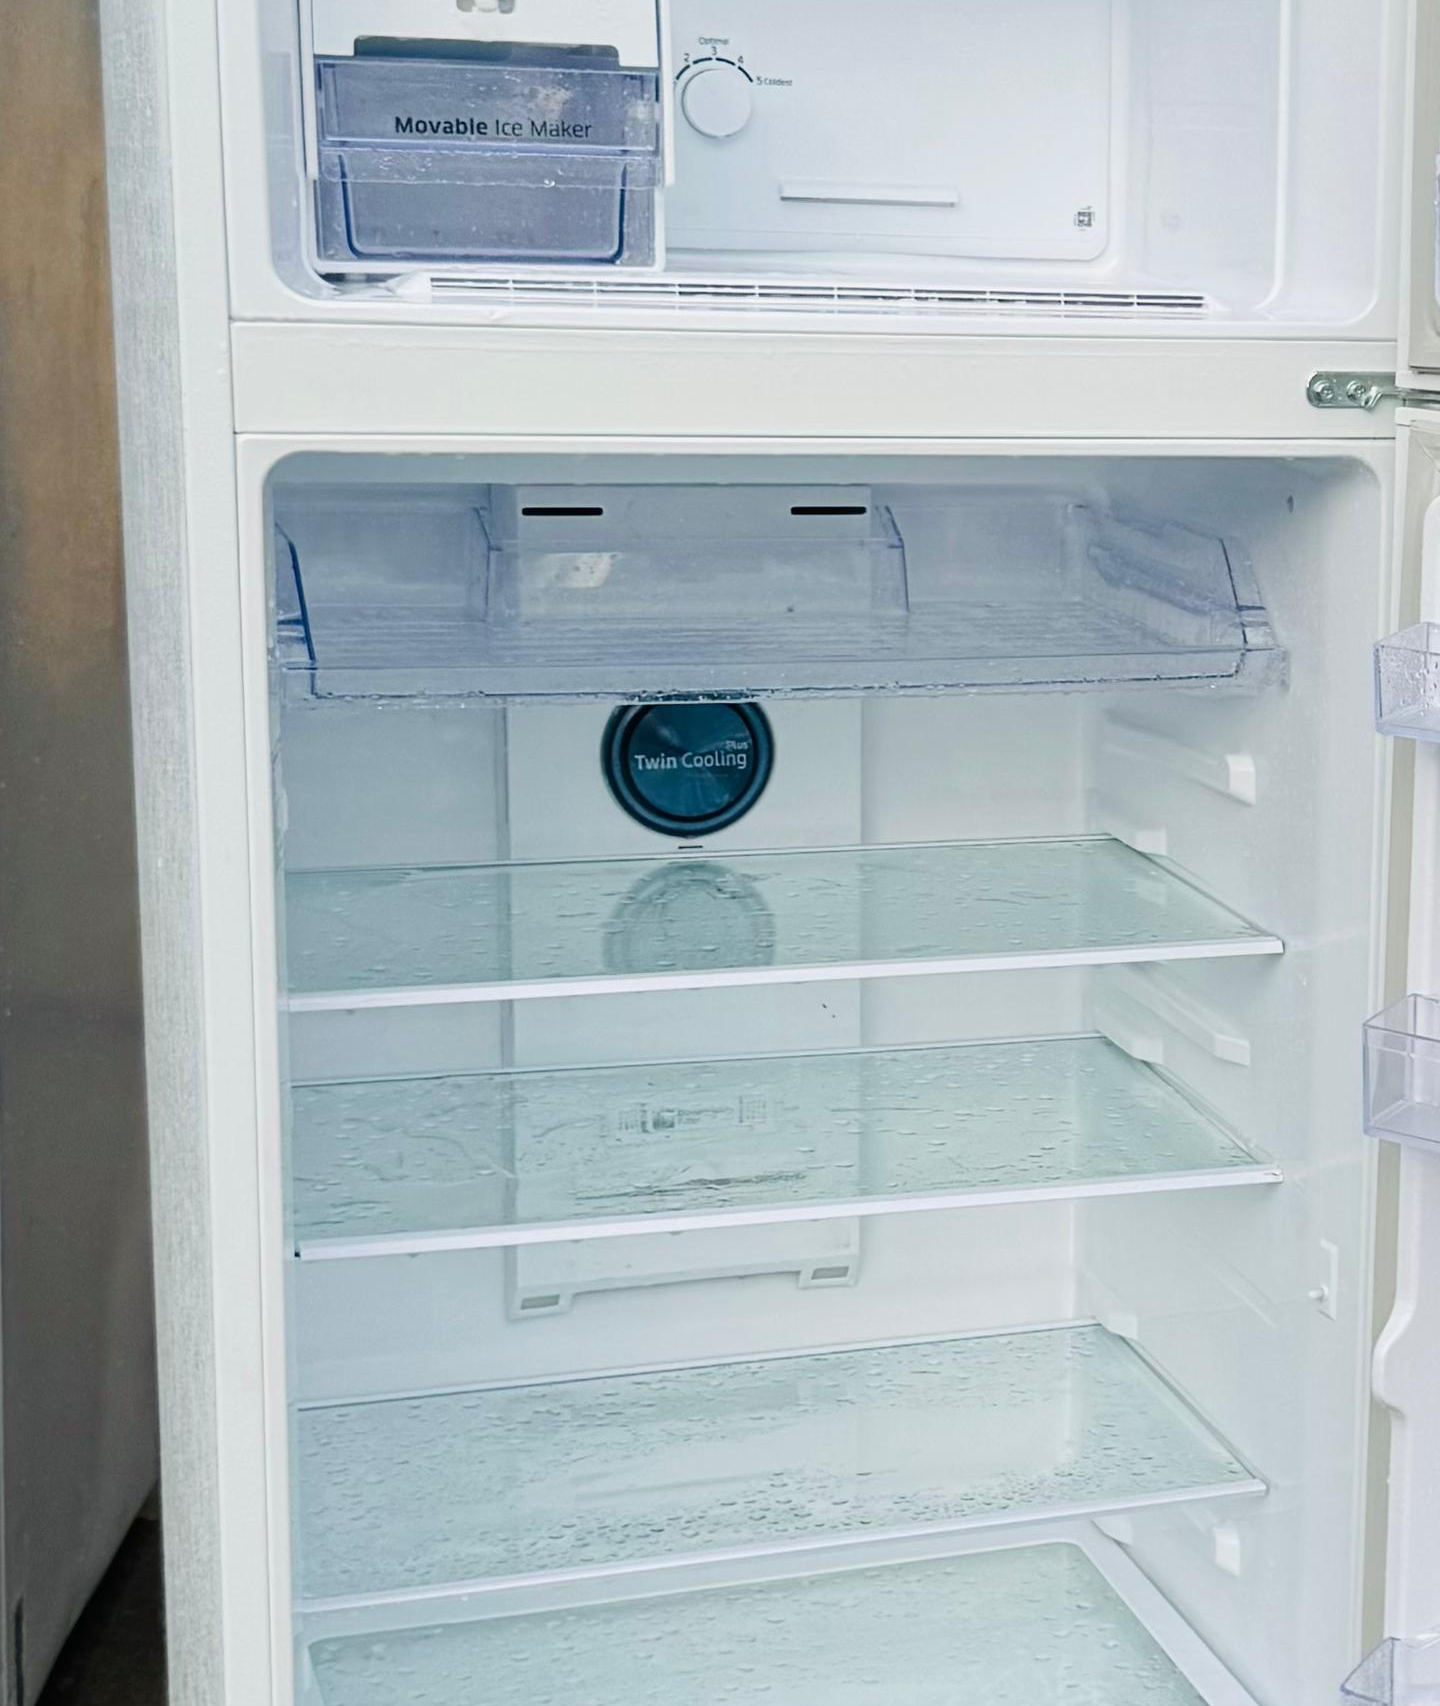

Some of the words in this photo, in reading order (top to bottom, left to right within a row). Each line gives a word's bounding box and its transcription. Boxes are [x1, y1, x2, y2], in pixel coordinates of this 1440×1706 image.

[711, 46, 717, 56] 3
[684, 53, 690, 62] 2
[737, 55, 744, 64] 4
[756, 76, 763, 86] 5
[395, 116, 488, 135] Movable
[495, 119, 523, 136] Ice
[530, 120, 592, 138] Maker
[725, 740, 748, 750] Plus
[634, 752, 677, 770] Twin
[682, 750, 747, 769] Cooling
